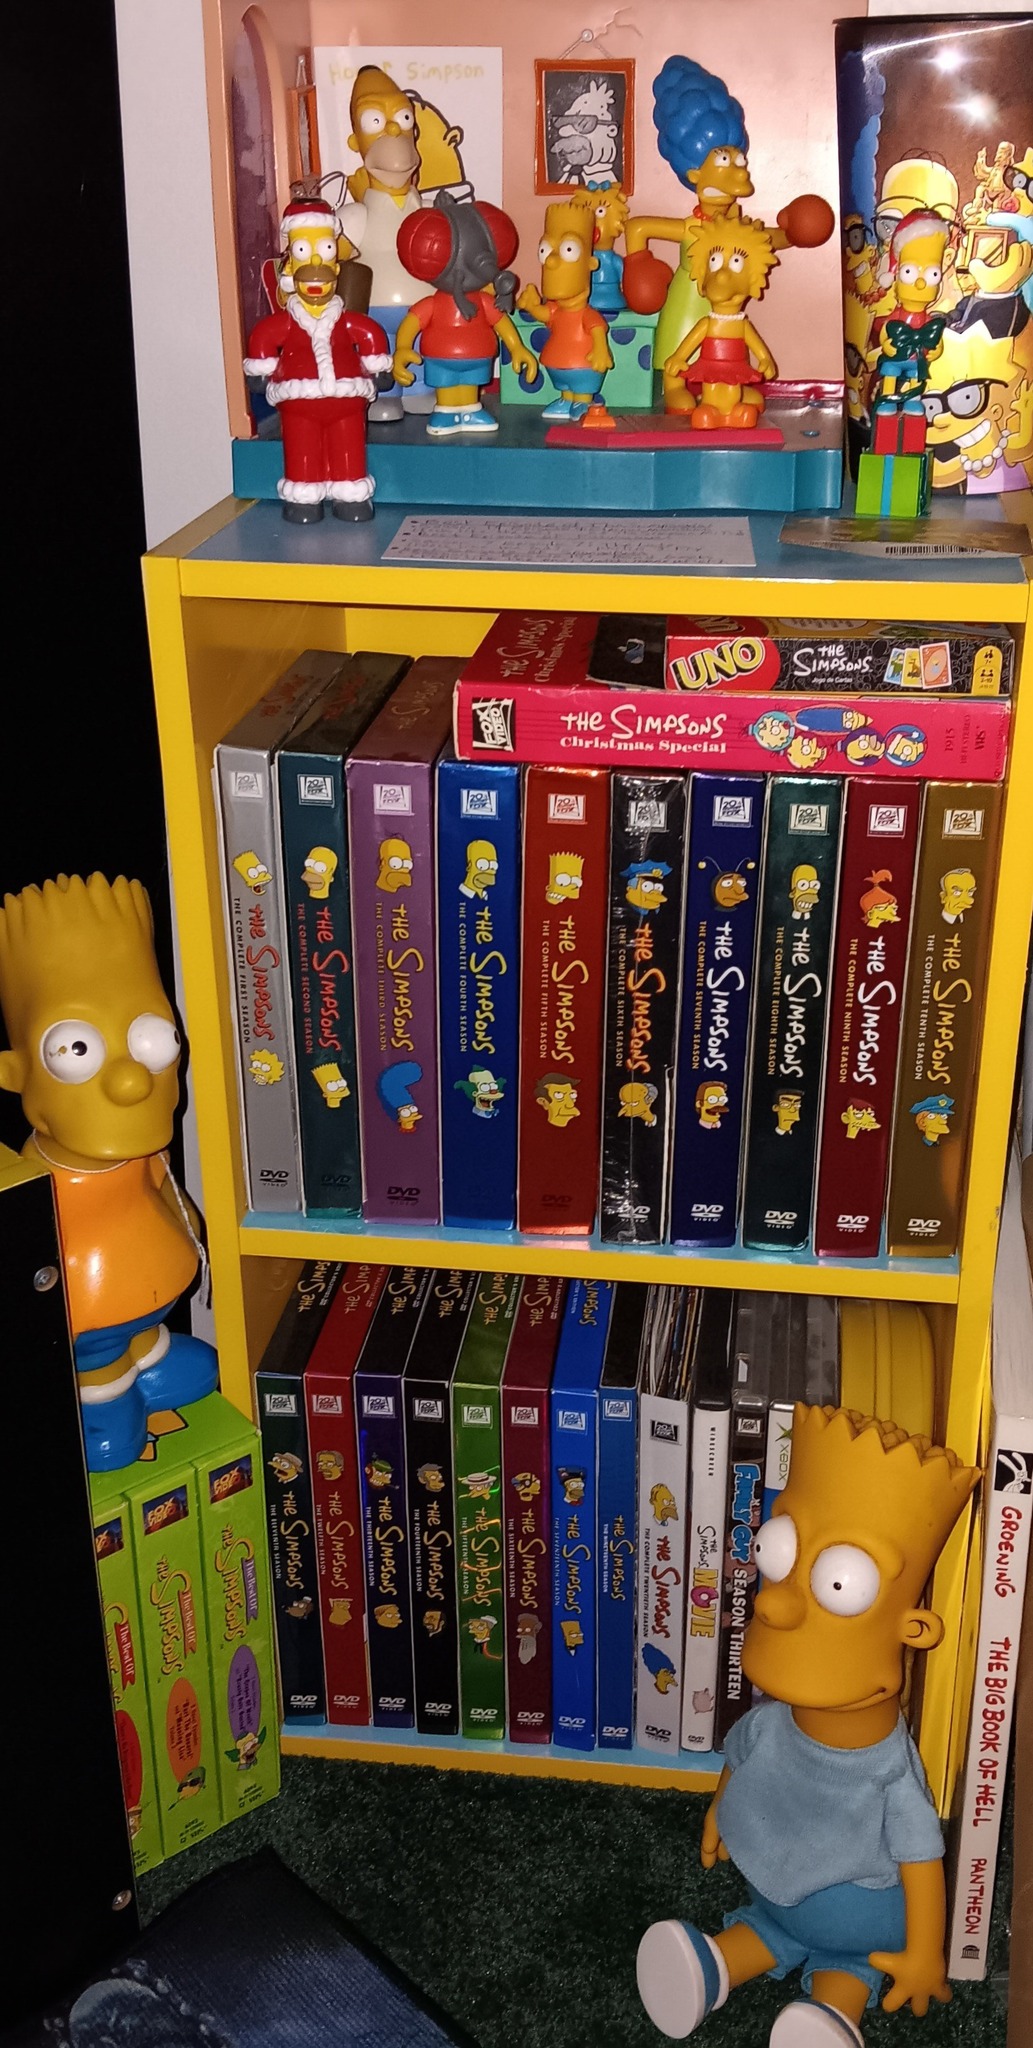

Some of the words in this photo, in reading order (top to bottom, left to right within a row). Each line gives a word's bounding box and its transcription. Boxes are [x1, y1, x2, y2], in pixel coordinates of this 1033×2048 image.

[407, 62, 484, 85] Simpson
[671, 636, 765, 690] UNO
[476, 709, 497, 744] FOX
[490, 708, 507, 745] VIDEO
[559, 737, 654, 751] Christmas
[658, 739, 726, 755] Special
[233, 898, 241, 915] THE
[297, 903, 306, 920] THE
[375, 902, 383, 919] THE
[458, 902, 466, 919] THE
[235, 919, 246, 970] COMPLETE
[541, 920, 550, 937] THE
[619, 927, 627, 944] THE
[698, 921, 707, 937] THE
[776, 926, 785, 944] THE
[925, 934, 936, 952] THE
[298, 924, 309, 972] COMPLETE
[375, 924, 386, 974] COMPLETE
[459, 923, 467, 971] COMPLETE
[541, 941, 550, 988] COMPLETE
[695, 941, 706, 988] COMPLETE
[849, 938, 858, 956] THE
[239, 974, 248, 1000] FIRST
[617, 948, 626, 996] COMPLETE
[772, 947, 784, 997] COMPLETE
[845, 959, 857, 1008] COMPLETE
[921, 954, 933, 1005] COMPLETE
[301, 976, 312, 1014] SECOND
[377, 979, 386, 1008] THIRD
[459, 975, 467, 1012] FOURTH
[540, 993, 549, 1018] FIFTH
[694, 989, 703, 1031] SEVENTH
[241, 1005, 251, 1043] SEASON
[378, 1012, 387, 1051] SEASON
[616, 1000, 625, 1027] SIXTH
[769, 1000, 780, 1034] EIGHTH
[842, 1011, 852, 1043] NINTH
[917, 1008, 929, 1039] TENTH
[303, 1018, 313, 1054] SEASON
[539, 1022, 548, 1059] SEASON
[615, 1031, 624, 1068] SEASON
[692, 1034, 701, 1070] SEASON
[767, 1038, 777, 1076] SEASON
[839, 1045, 850, 1084] SEASON
[915, 1042, 926, 1080] SEASON
[260, 1169, 289, 1179] DVD
[691, 1204, 724, 1213] DVD
[764, 1211, 798, 1220] DVD
[837, 1215, 870, 1224] DVD
[908, 1219, 941, 1228] DVD
[732, 1463, 761, 1525] FAMILY
[730, 1524, 754, 1563] GUY
[995, 1505, 1023, 1598] GROENING
[690, 1568, 720, 1638] MOVIE
[731, 1568, 748, 1627] SEASON
[727, 1632, 744, 1700] THIRTEEN
[990, 1636, 1012, 1672] THE
[425, 1702, 452, 1710] DVD
[984, 1677, 1008, 1705] BIG
[979, 1708, 1006, 1753] BOOK
[977, 1758, 999, 1780] OF
[973, 1784, 997, 1827] HELL
[964, 1858, 987, 1934] PANTHEON
